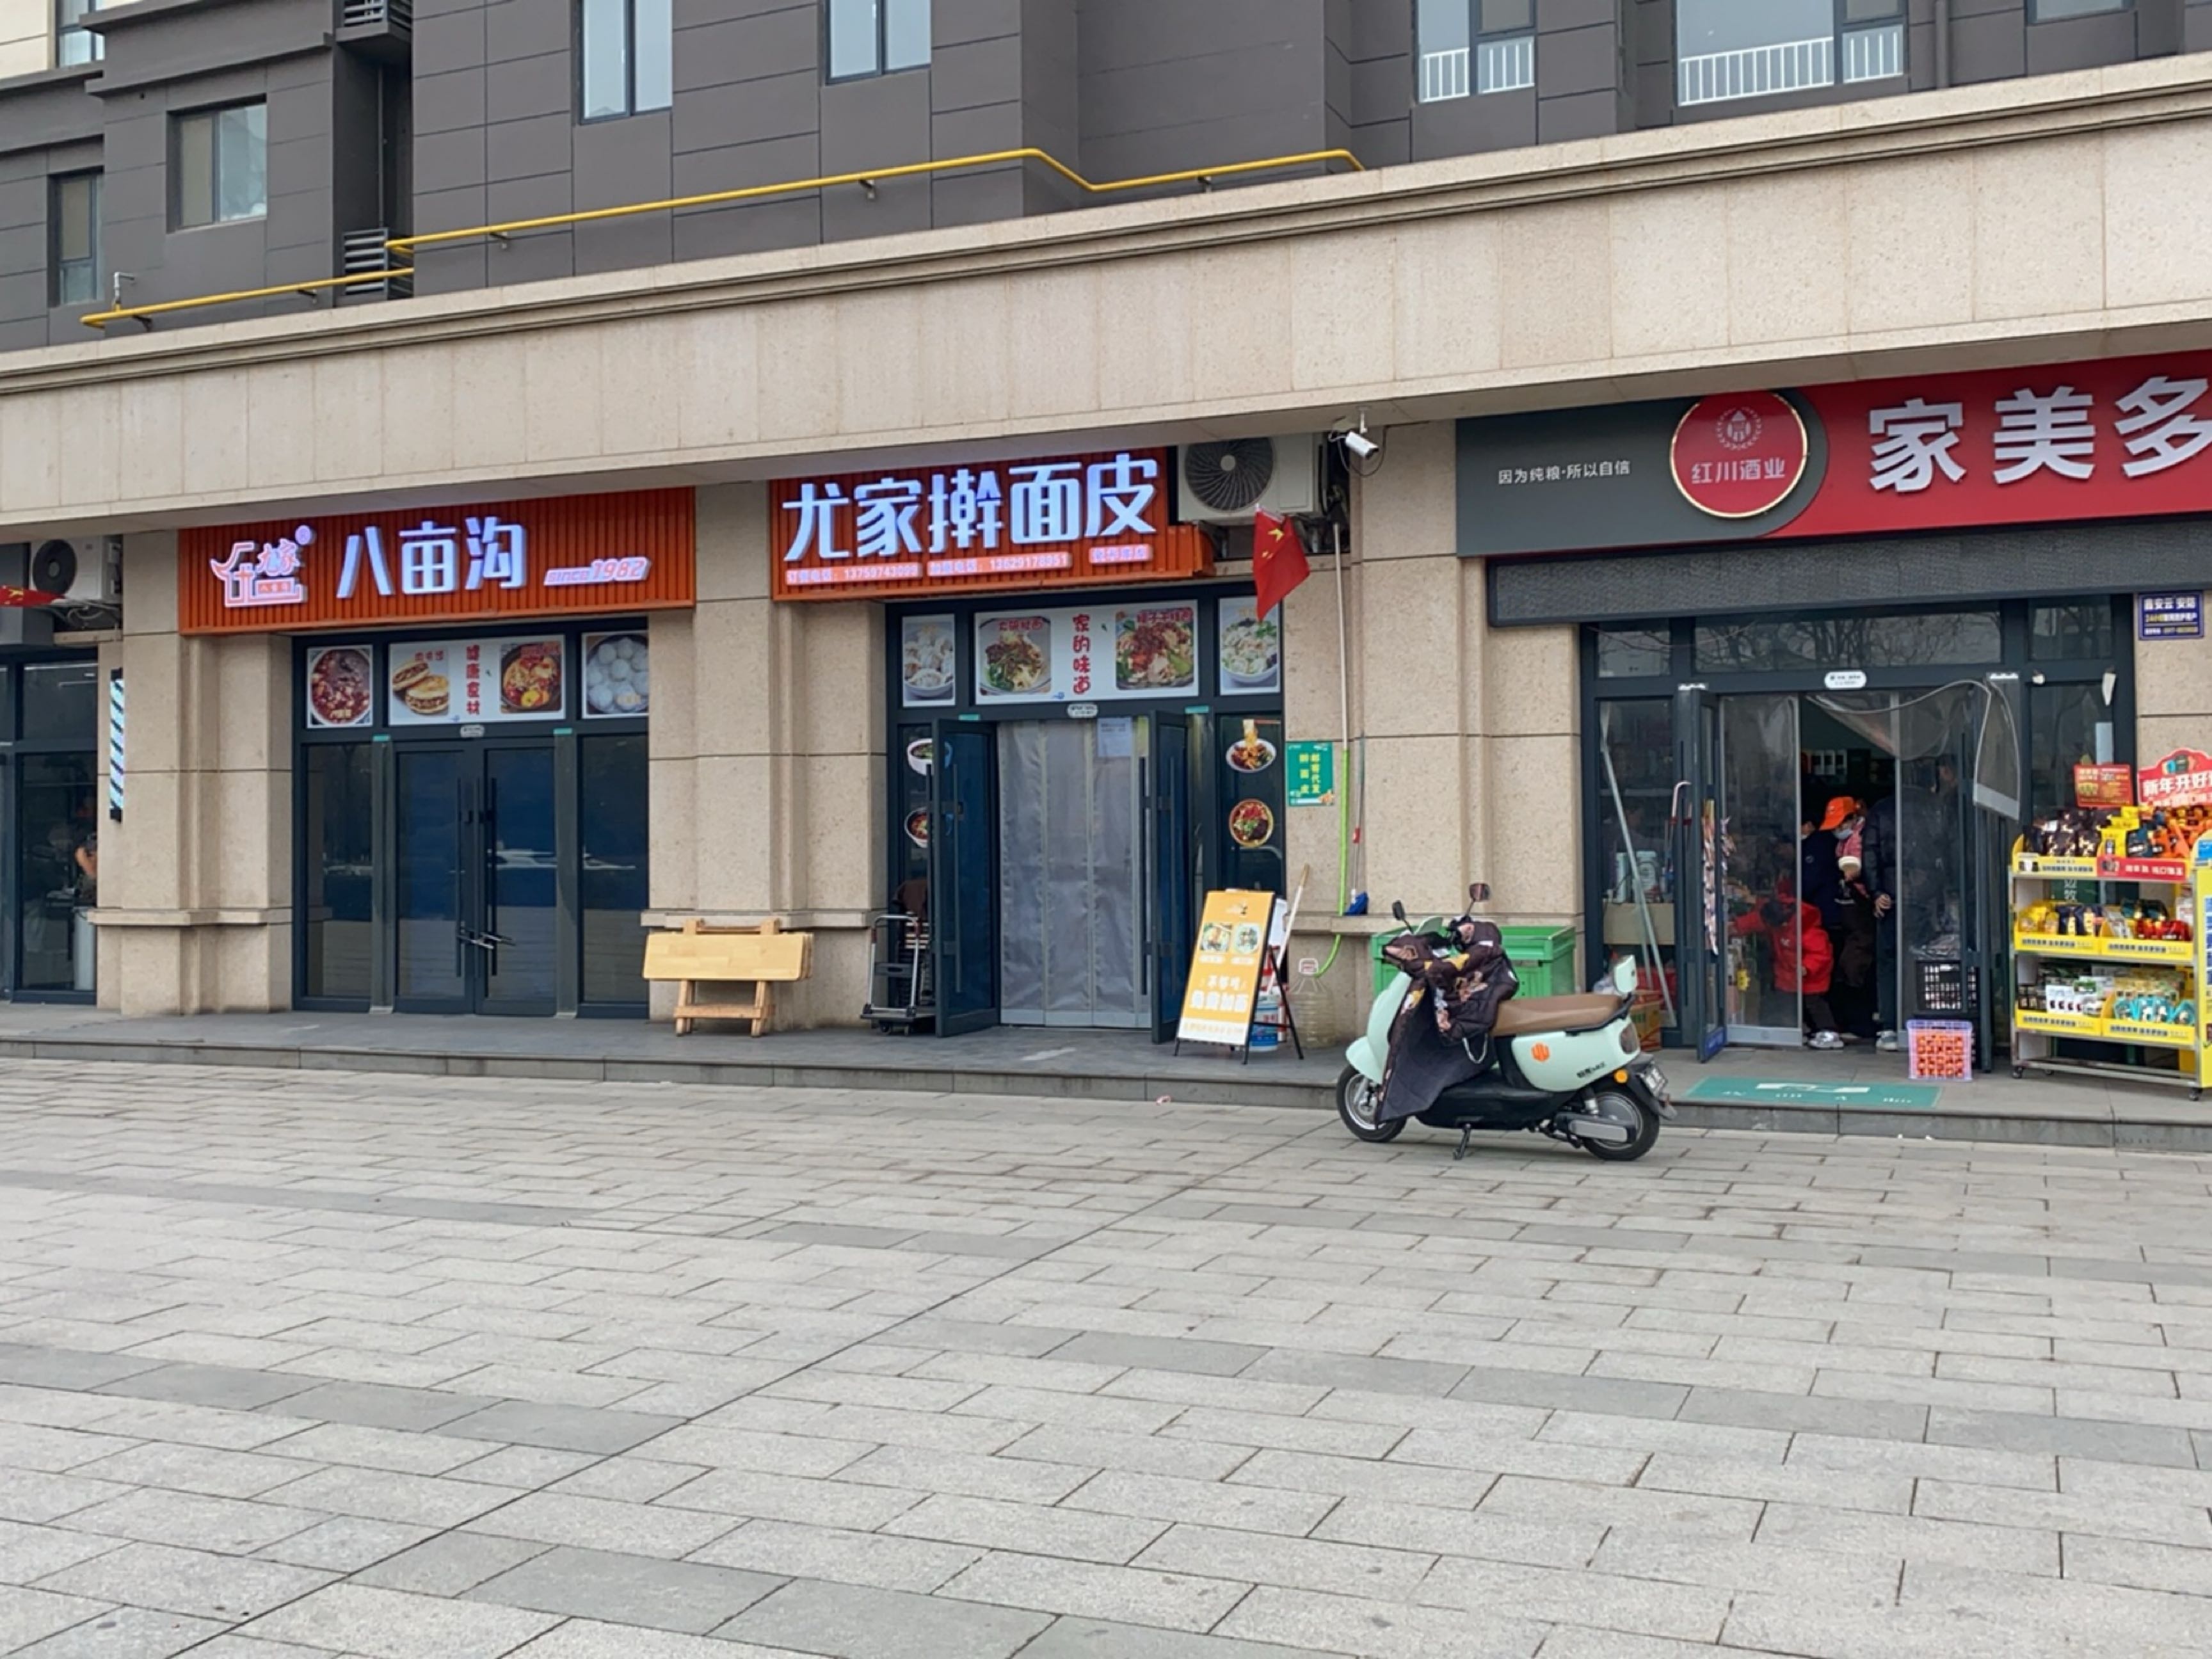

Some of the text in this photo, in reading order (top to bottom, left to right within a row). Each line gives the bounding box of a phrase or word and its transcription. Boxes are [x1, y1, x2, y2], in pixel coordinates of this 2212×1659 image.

[1869, 376, 2212, 493] 家美多
[1498, 460, 1631, 485] 因为纯粮·所以自信
[1691, 457, 1786, 485] 红川酒业
[782, 452, 1158, 562] 尤家擀面皮
[336, 516, 525, 599] 八亩沟
[593, 559, 646, 581] 1982
[1071, 613, 1092, 696] 家的味道
[2143, 770, 2212, 797] 新年开好
